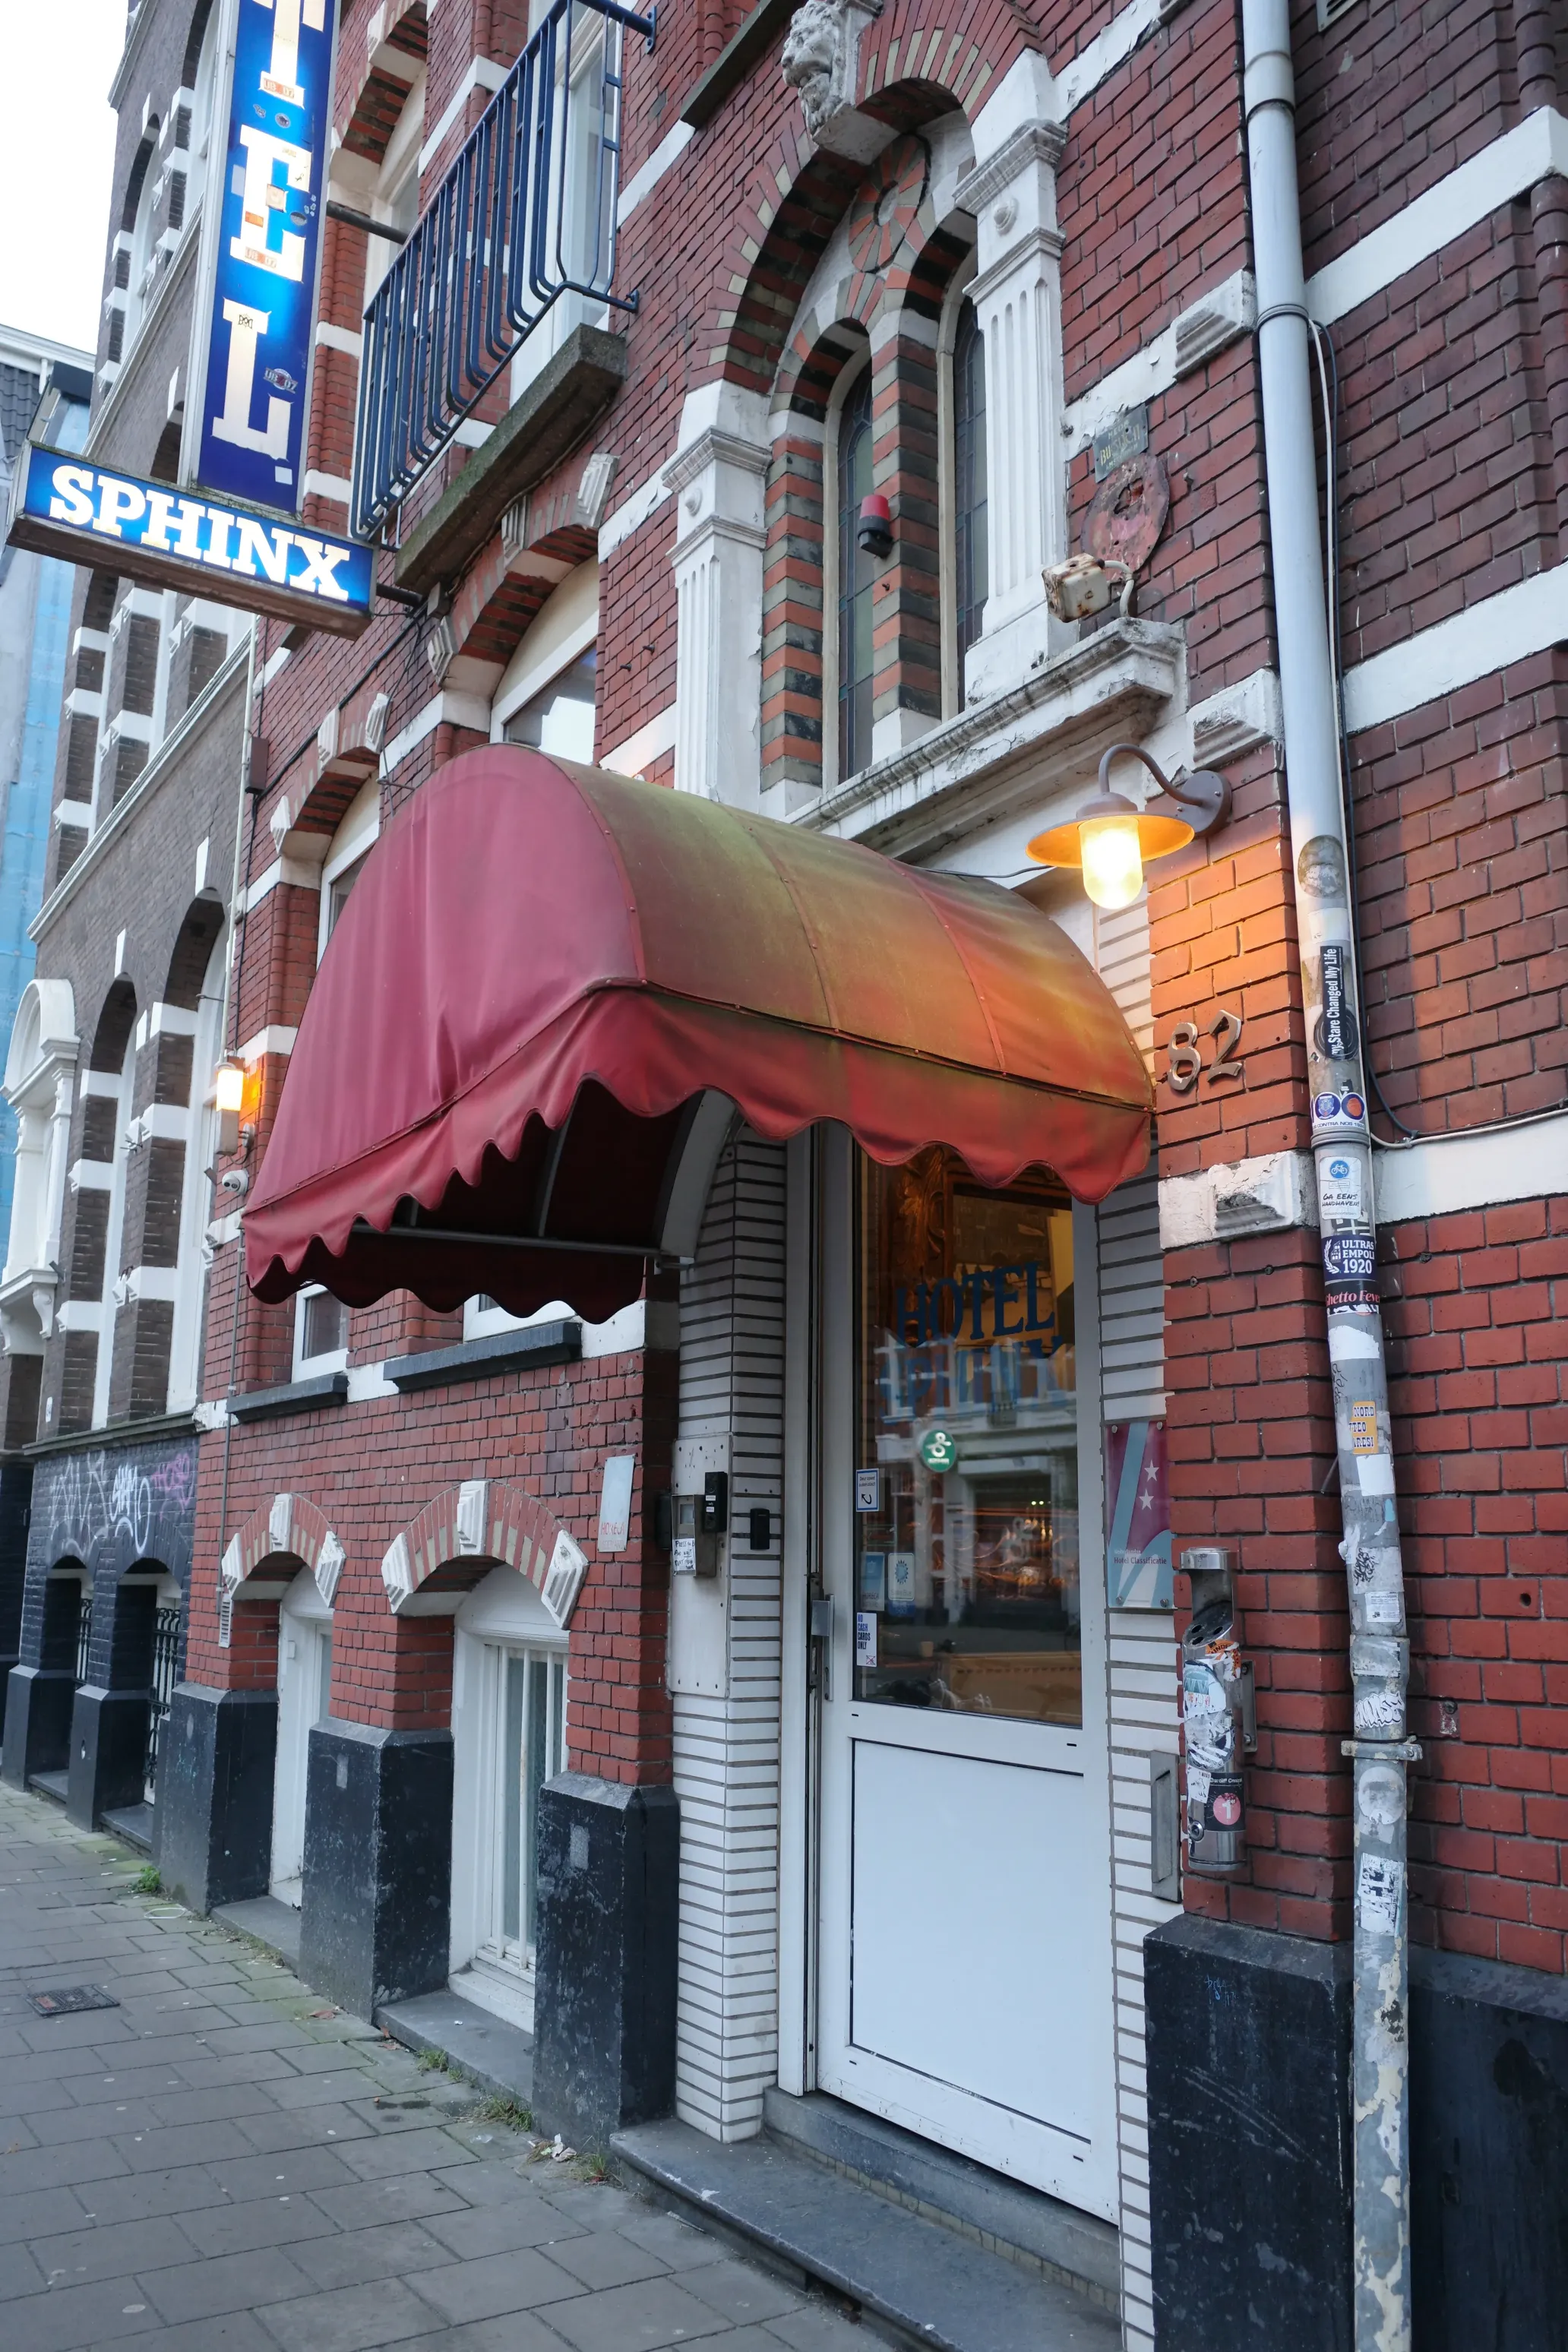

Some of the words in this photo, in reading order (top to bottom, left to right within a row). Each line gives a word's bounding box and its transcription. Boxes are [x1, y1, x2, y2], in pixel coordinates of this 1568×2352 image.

[49, 465, 351, 602] SPHINX
[1323, 948, 1338, 965] Life
[1324, 966, 1341, 979] My
[1325, 980, 1342, 1019] Changed
[1328, 1020, 1342, 1042] Stare
[1167, 1009, 1243, 1091] 82
[1342, 1239, 1374, 1250] ULTRAS
[1342, 1249, 1375, 1260] EMPOLI
[1342, 1258, 1373, 1274] 1920
[895, 1262, 1055, 1348] HOTEL
[1354, 1406, 1374, 1417] NORD
[857, 1614, 864, 1623] NO
[857, 1623, 868, 1632] CASH
[857, 1632, 871, 1641] CARDS
[857, 1641, 868, 1650] ONLY
